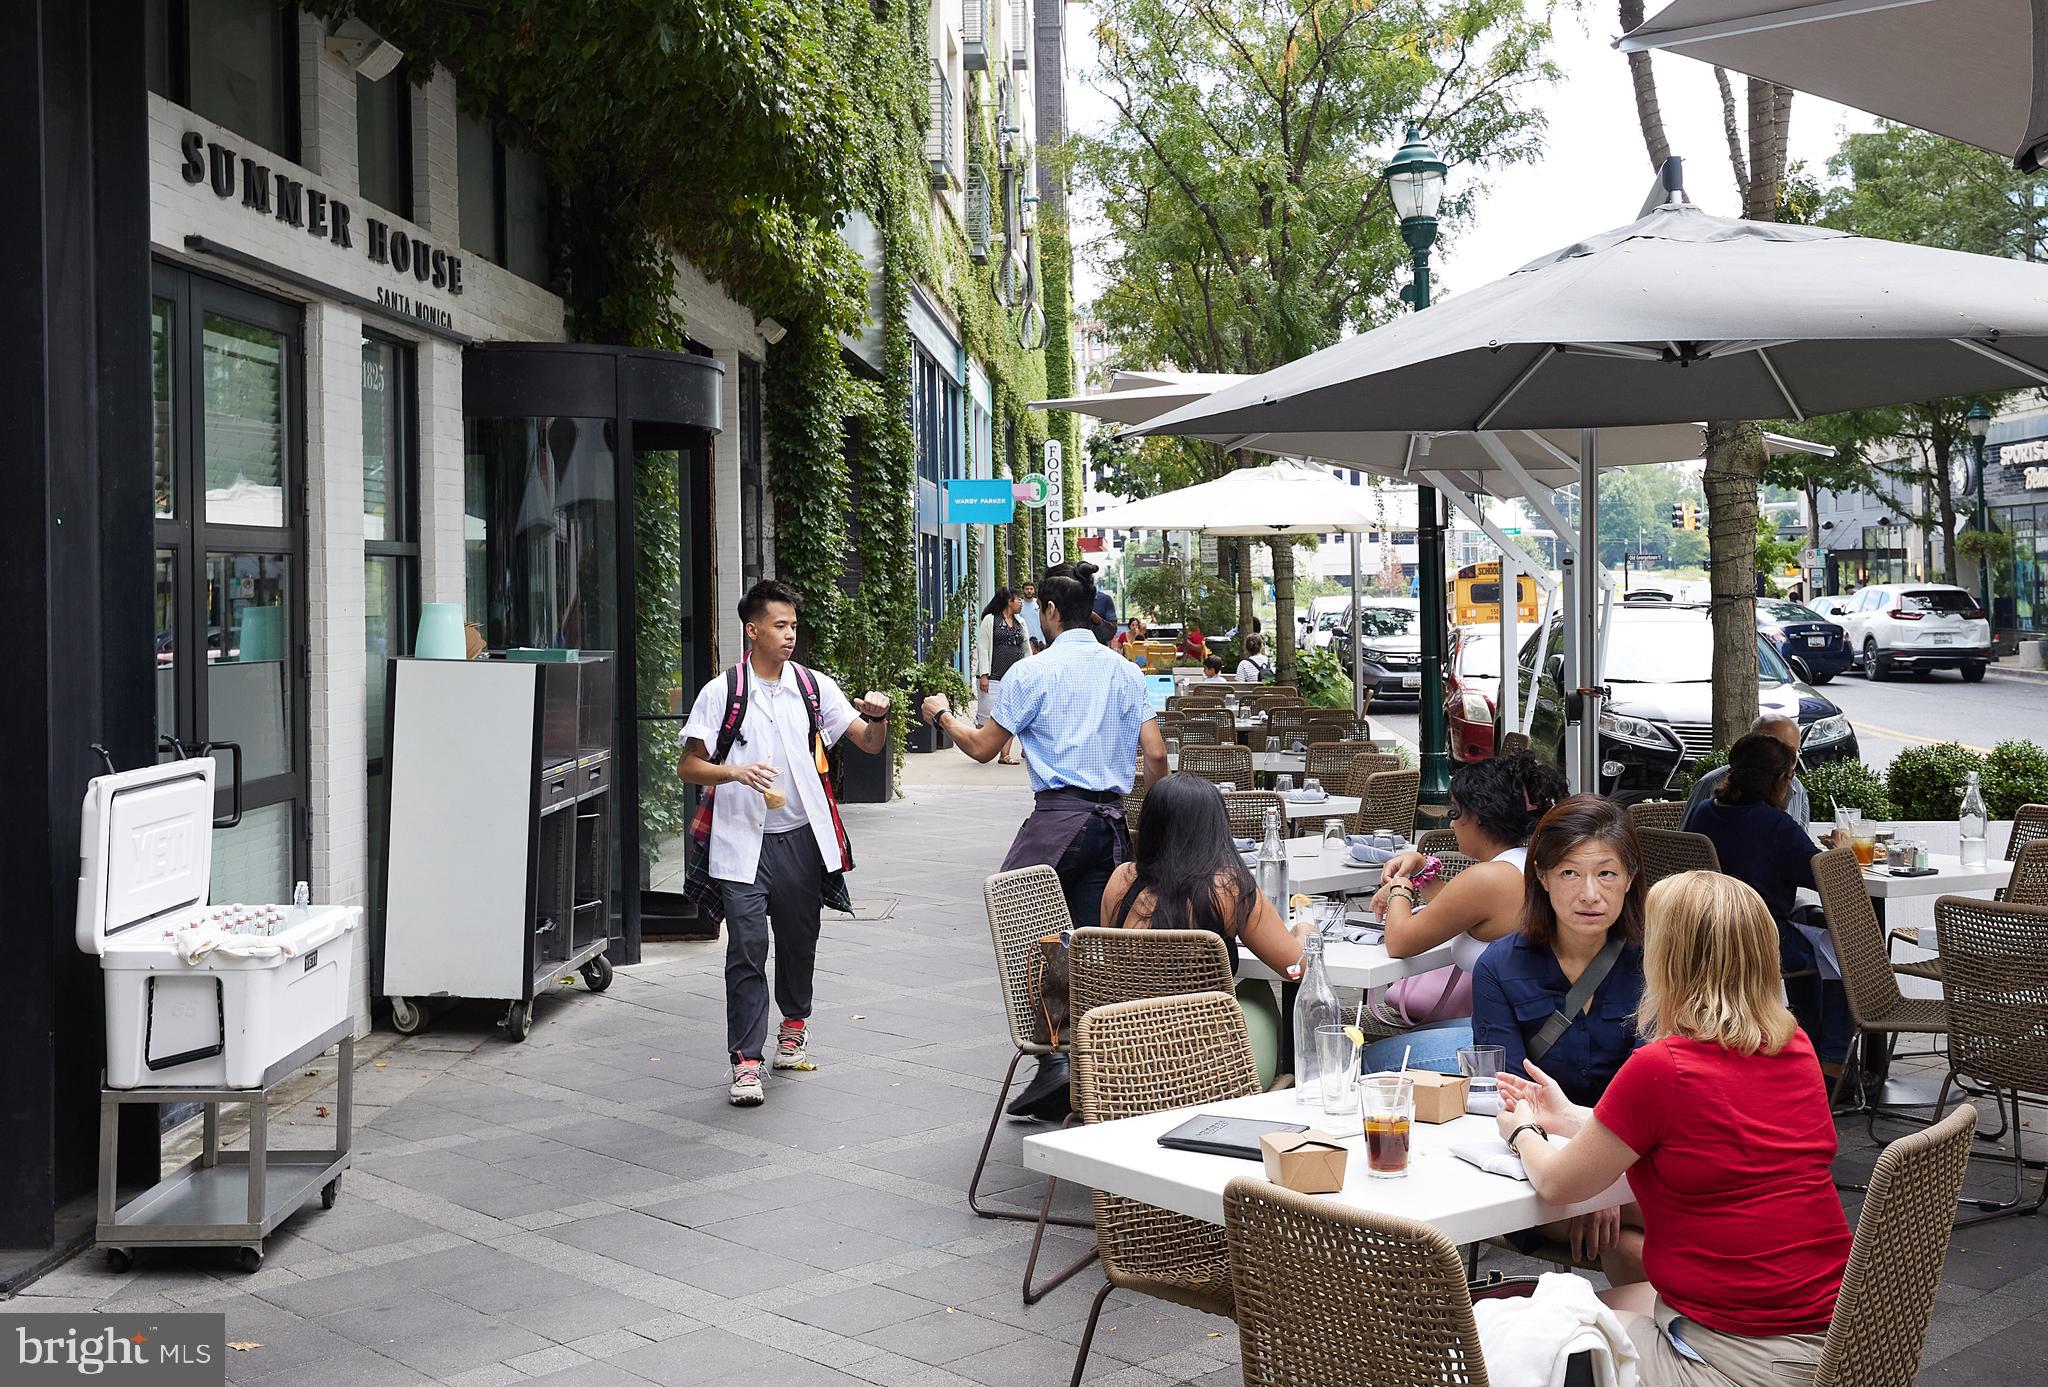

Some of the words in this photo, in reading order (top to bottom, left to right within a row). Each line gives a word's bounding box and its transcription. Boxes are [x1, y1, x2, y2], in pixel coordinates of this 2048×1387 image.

[181, 131, 353, 249] SUMMER
[366, 218, 464, 295] HOUSE
[377, 286, 411, 315] SANTA
[415, 300, 453, 330] MONICA
[362, 360, 385, 392] 1825
[131, 819, 194, 884] YETI
[305, 952, 317, 970] YETI
